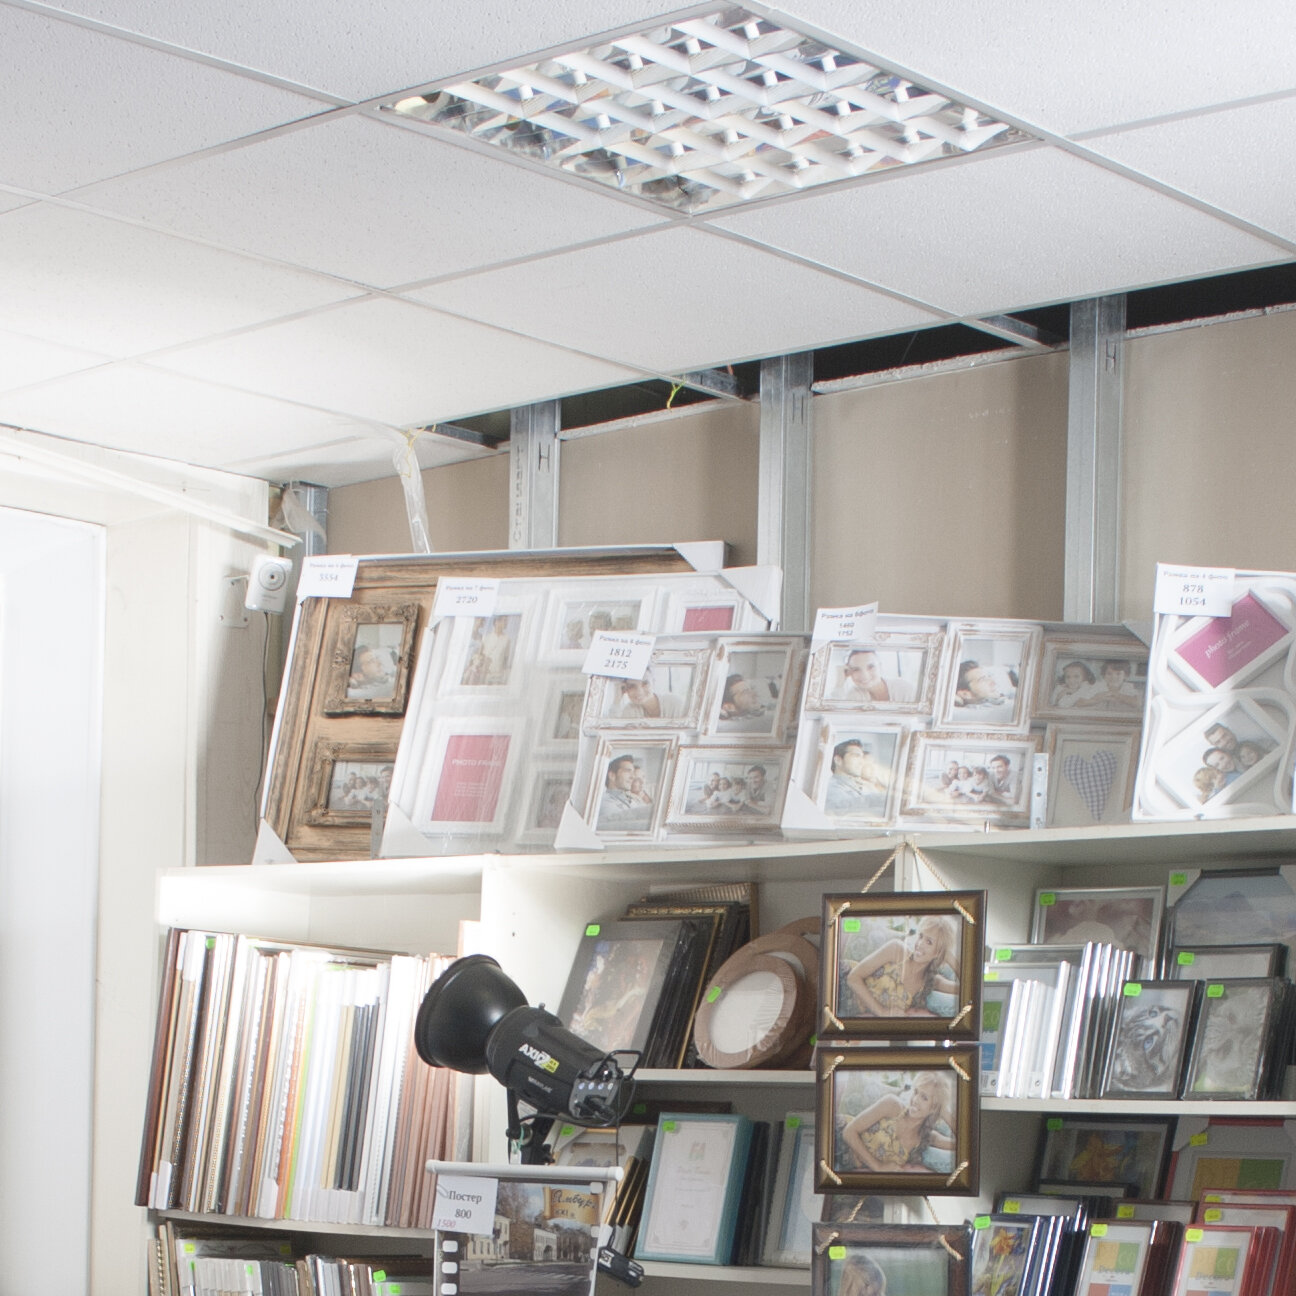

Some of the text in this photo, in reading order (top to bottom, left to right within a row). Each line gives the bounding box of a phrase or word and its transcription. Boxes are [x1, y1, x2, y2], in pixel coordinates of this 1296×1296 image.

[1182, 584, 1204, 593] 878
[455, 595, 478, 604] 2720
[1179, 597, 1207, 606] 1054
[609, 647, 632, 657] 1812
[604, 659, 628, 669] 2175
[451, 758, 477, 767] PHOTO
[448, 1190, 483, 1205] Постер
[454, 1208, 472, 1219] 800
[437, 1218, 456, 1229] 1500
